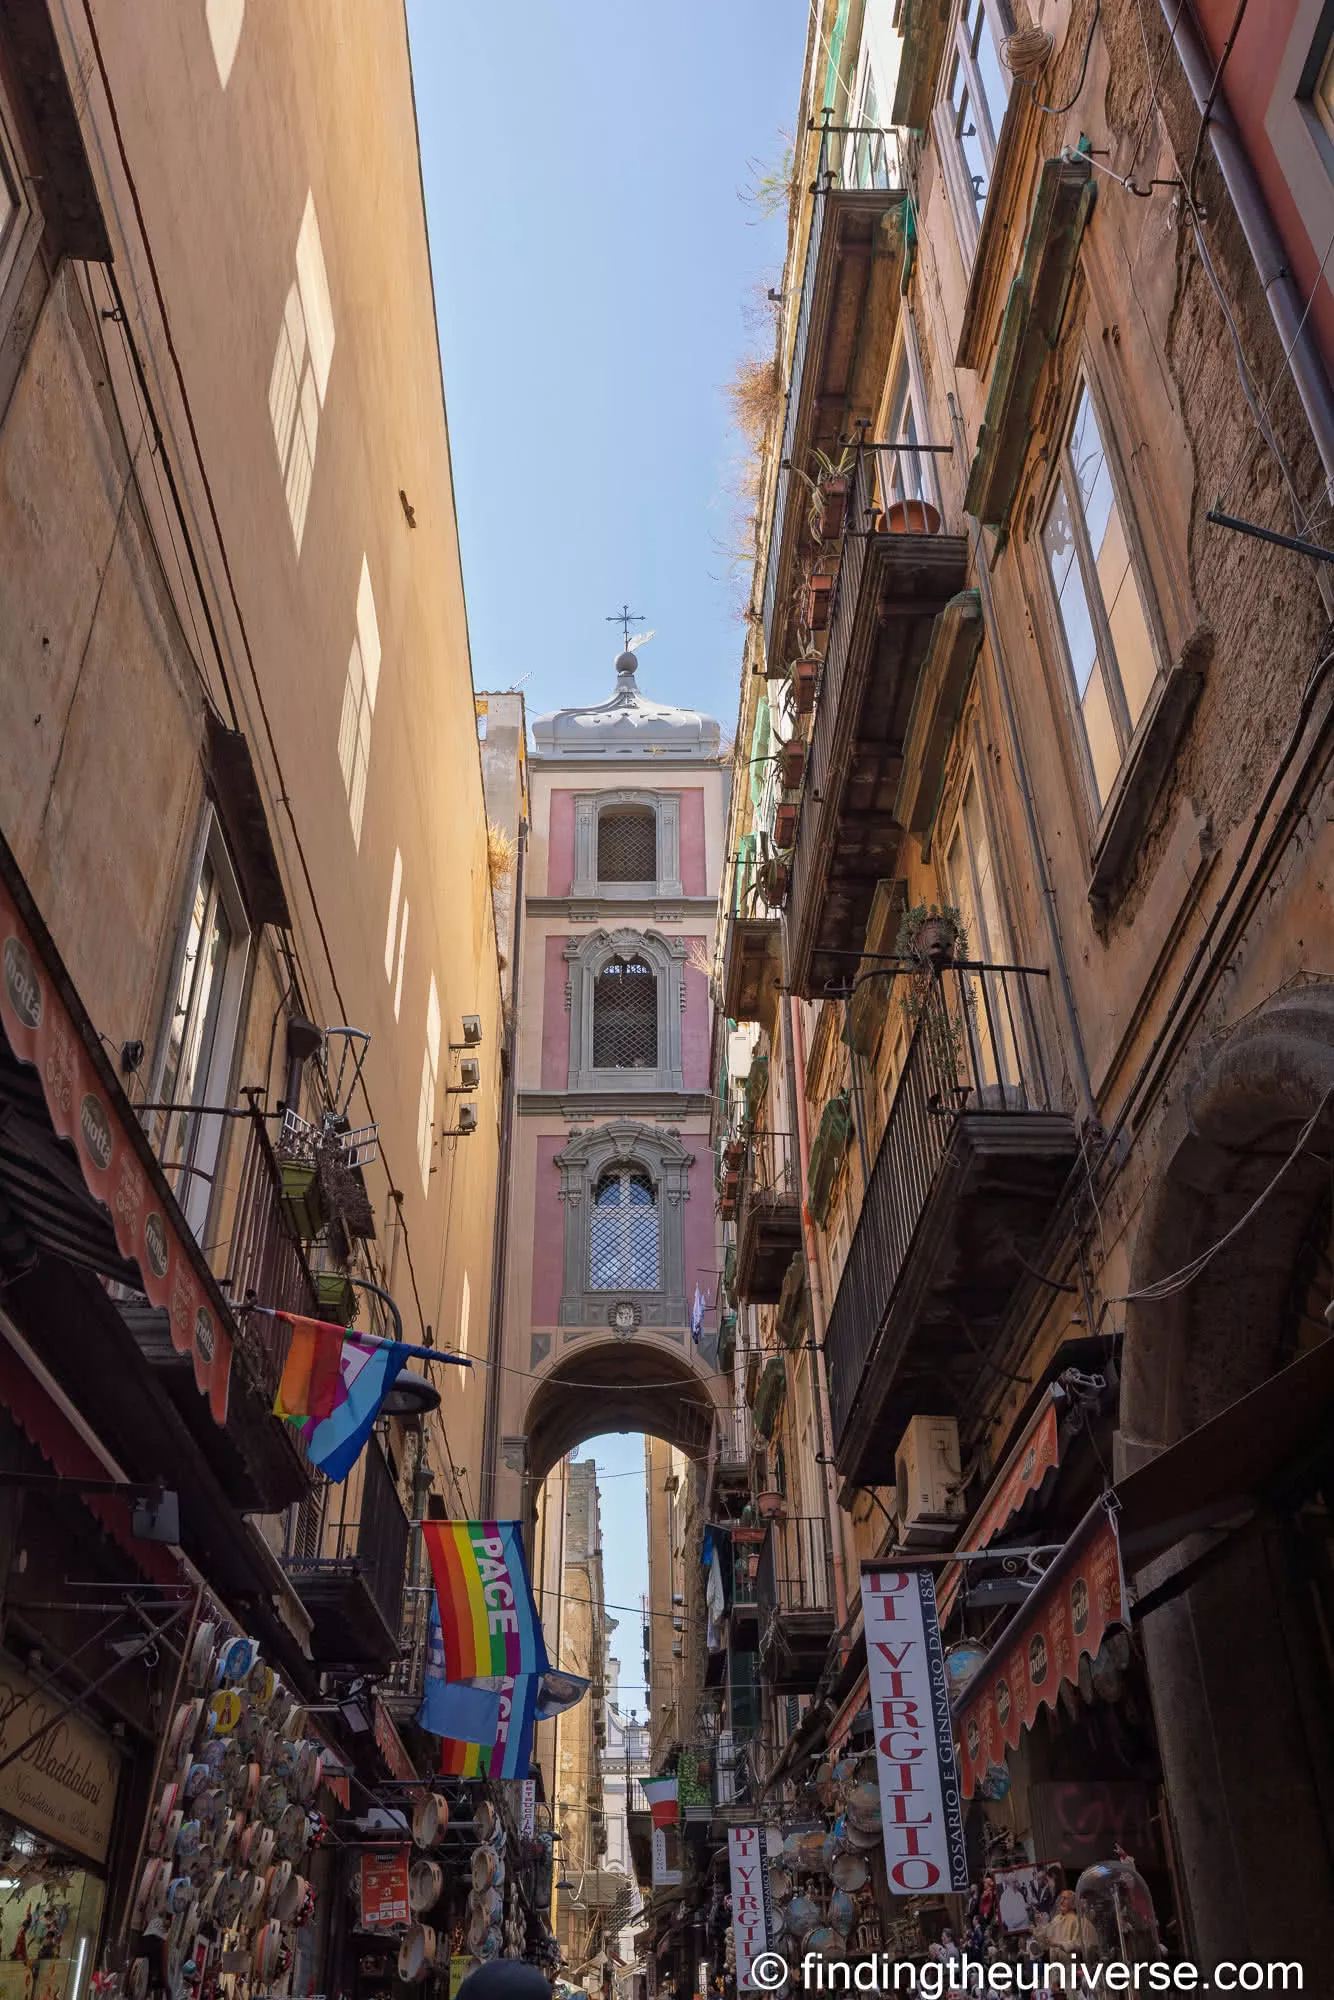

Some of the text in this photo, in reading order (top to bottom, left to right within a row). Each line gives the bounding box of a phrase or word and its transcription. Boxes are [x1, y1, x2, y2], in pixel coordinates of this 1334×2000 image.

[5, 949, 41, 1027] motta
[81, 1104, 112, 1161] motta
[472, 1537, 519, 1635] PACE
[927, 1614, 943, 1651] DAL
[494, 1675, 516, 1745] ACE
[864, 1573, 941, 1890] DI VIRGILIO
[931, 1659, 953, 1763] GENNARO
[943, 1770, 955, 1781] E
[945, 1789, 967, 1889] ROSARIO
[735, 1827, 764, 1988] DI VIRGILIO
